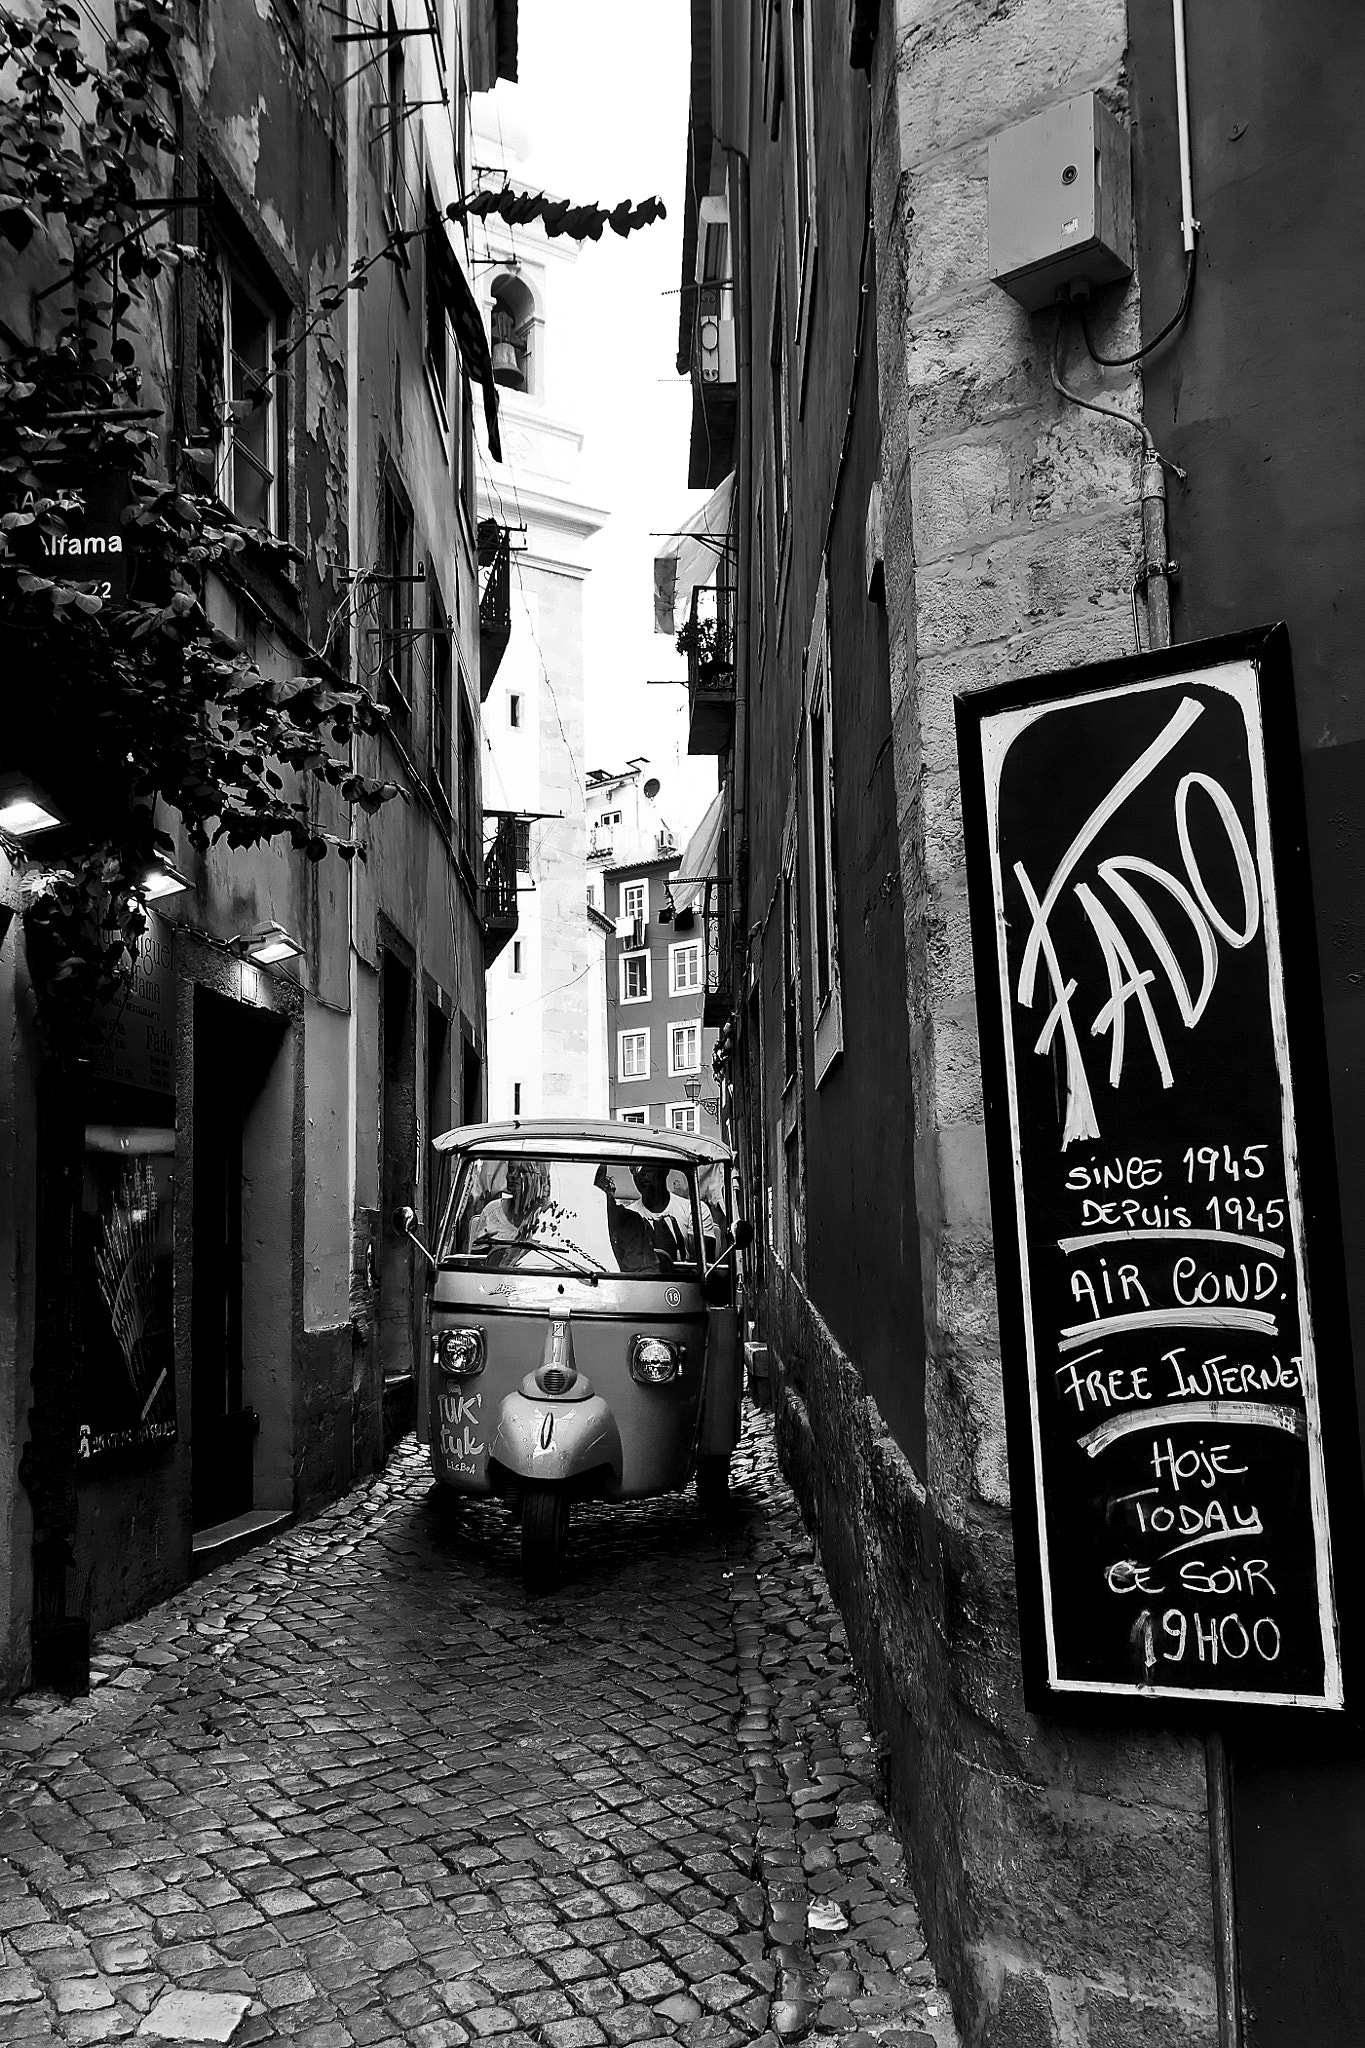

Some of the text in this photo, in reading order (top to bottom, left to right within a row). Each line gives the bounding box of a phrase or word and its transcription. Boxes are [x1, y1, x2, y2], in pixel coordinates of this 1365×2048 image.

[137, 932, 174, 976] iguel
[145, 1024, 173, 1056] Fado
[1183, 1145, 1269, 1183] 1945
[1206, 1195, 1286, 1234] 1945
[667, 1292, 679, 1302] 18
[1172, 1256, 1288, 1306] COND.
[1055, 1347, 1306, 1412] FREE INTERNET
[1134, 1608, 1281, 1667] 19H00
